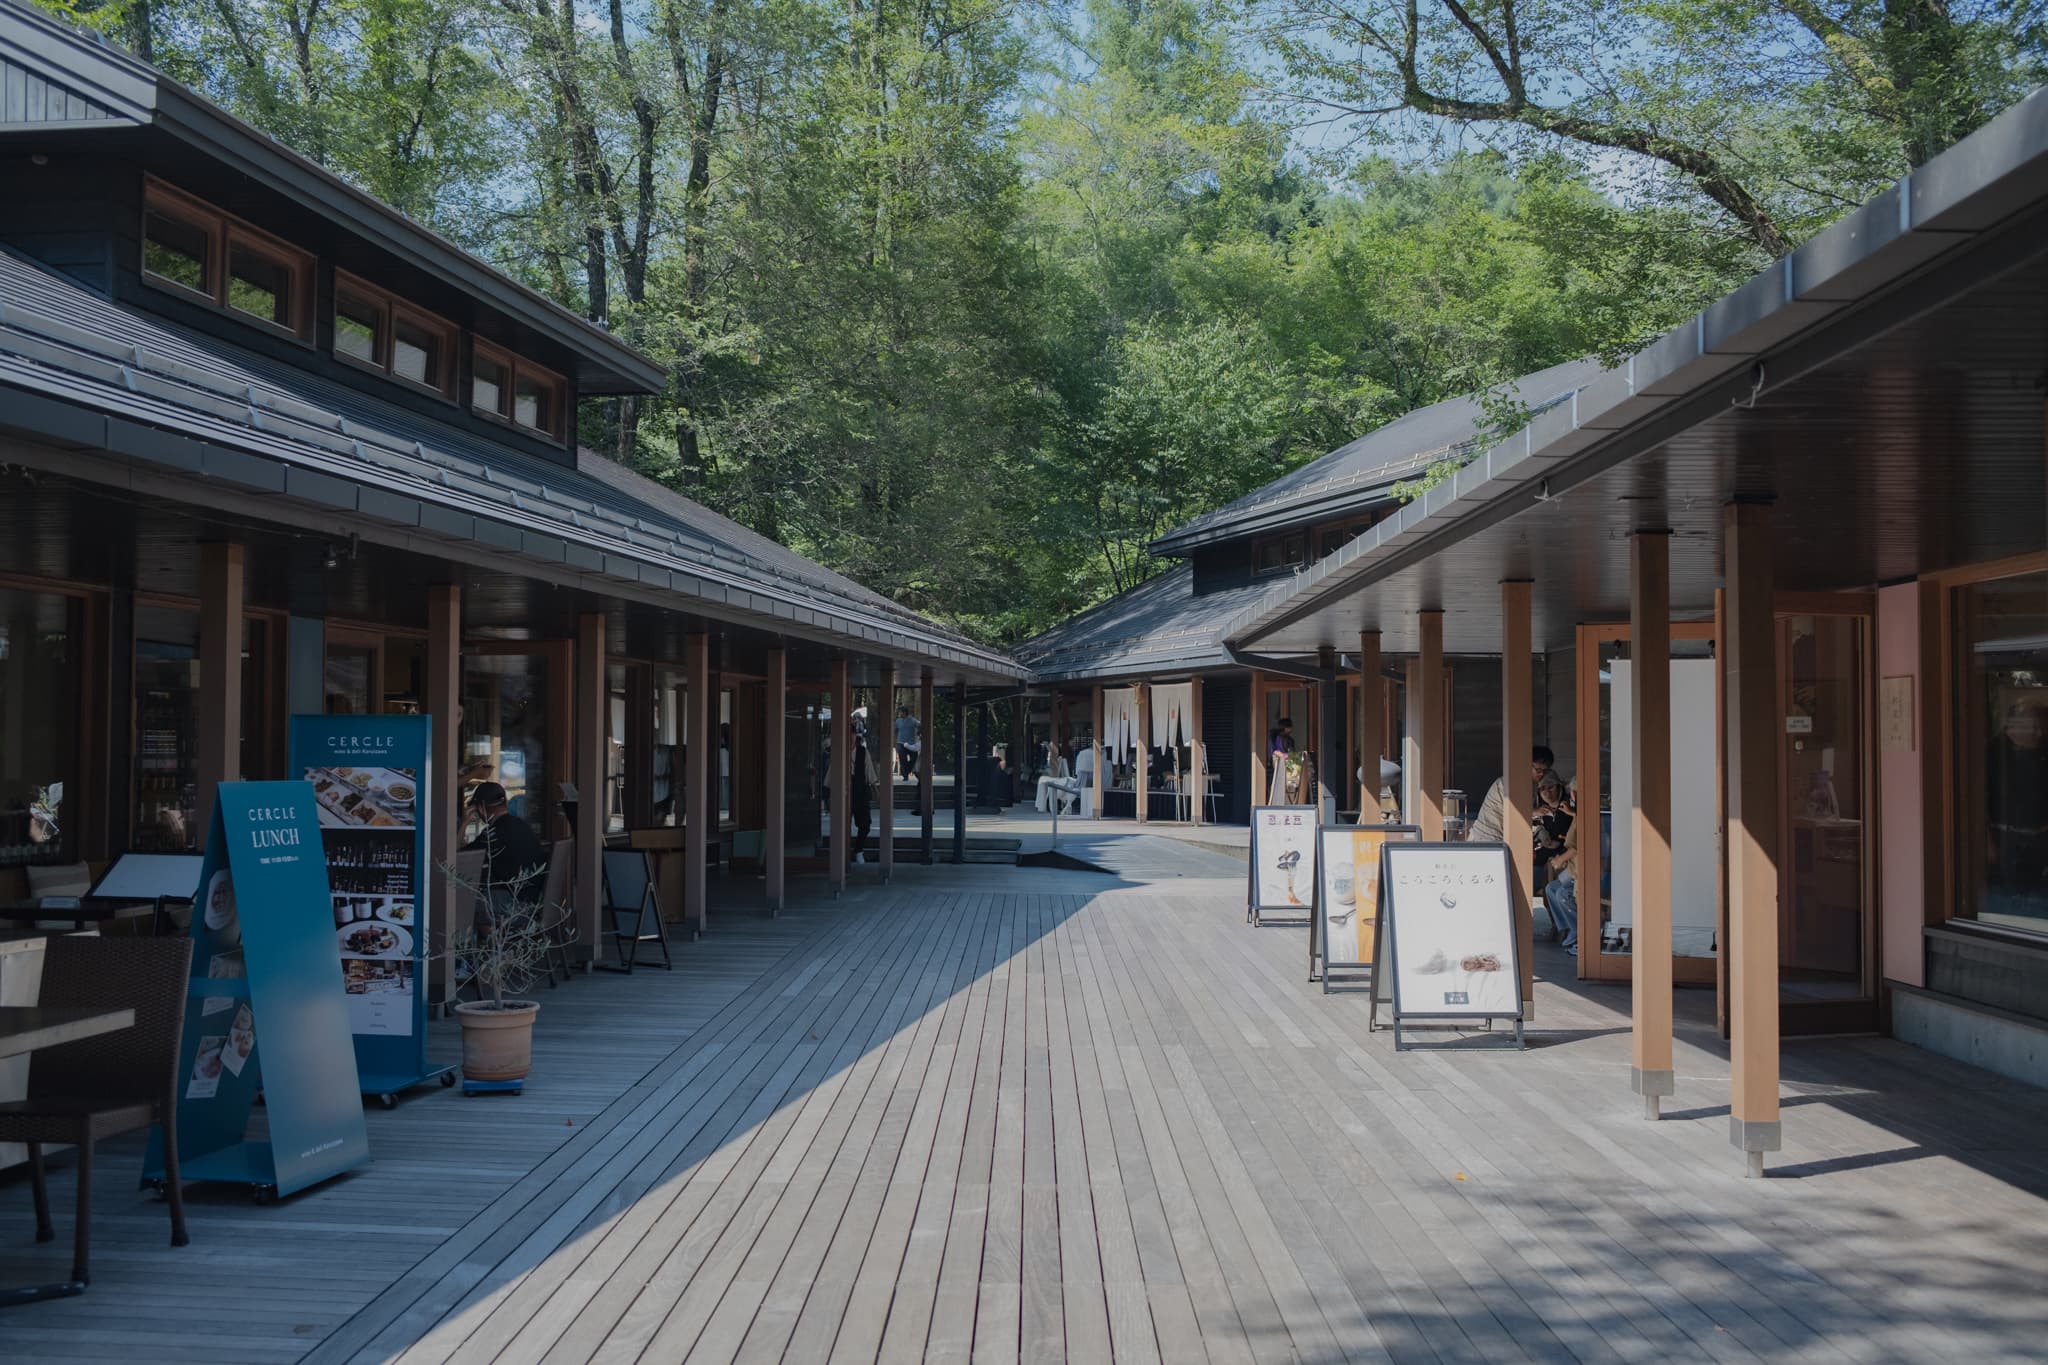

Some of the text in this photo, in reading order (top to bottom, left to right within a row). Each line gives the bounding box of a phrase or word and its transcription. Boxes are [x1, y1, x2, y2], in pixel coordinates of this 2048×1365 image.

[327, 736, 394, 747] CERCLE
[248, 807, 296, 821] CERCLE
[251, 827, 300, 849] LUNCH
[1399, 873, 1495, 885] ころころくるみ
